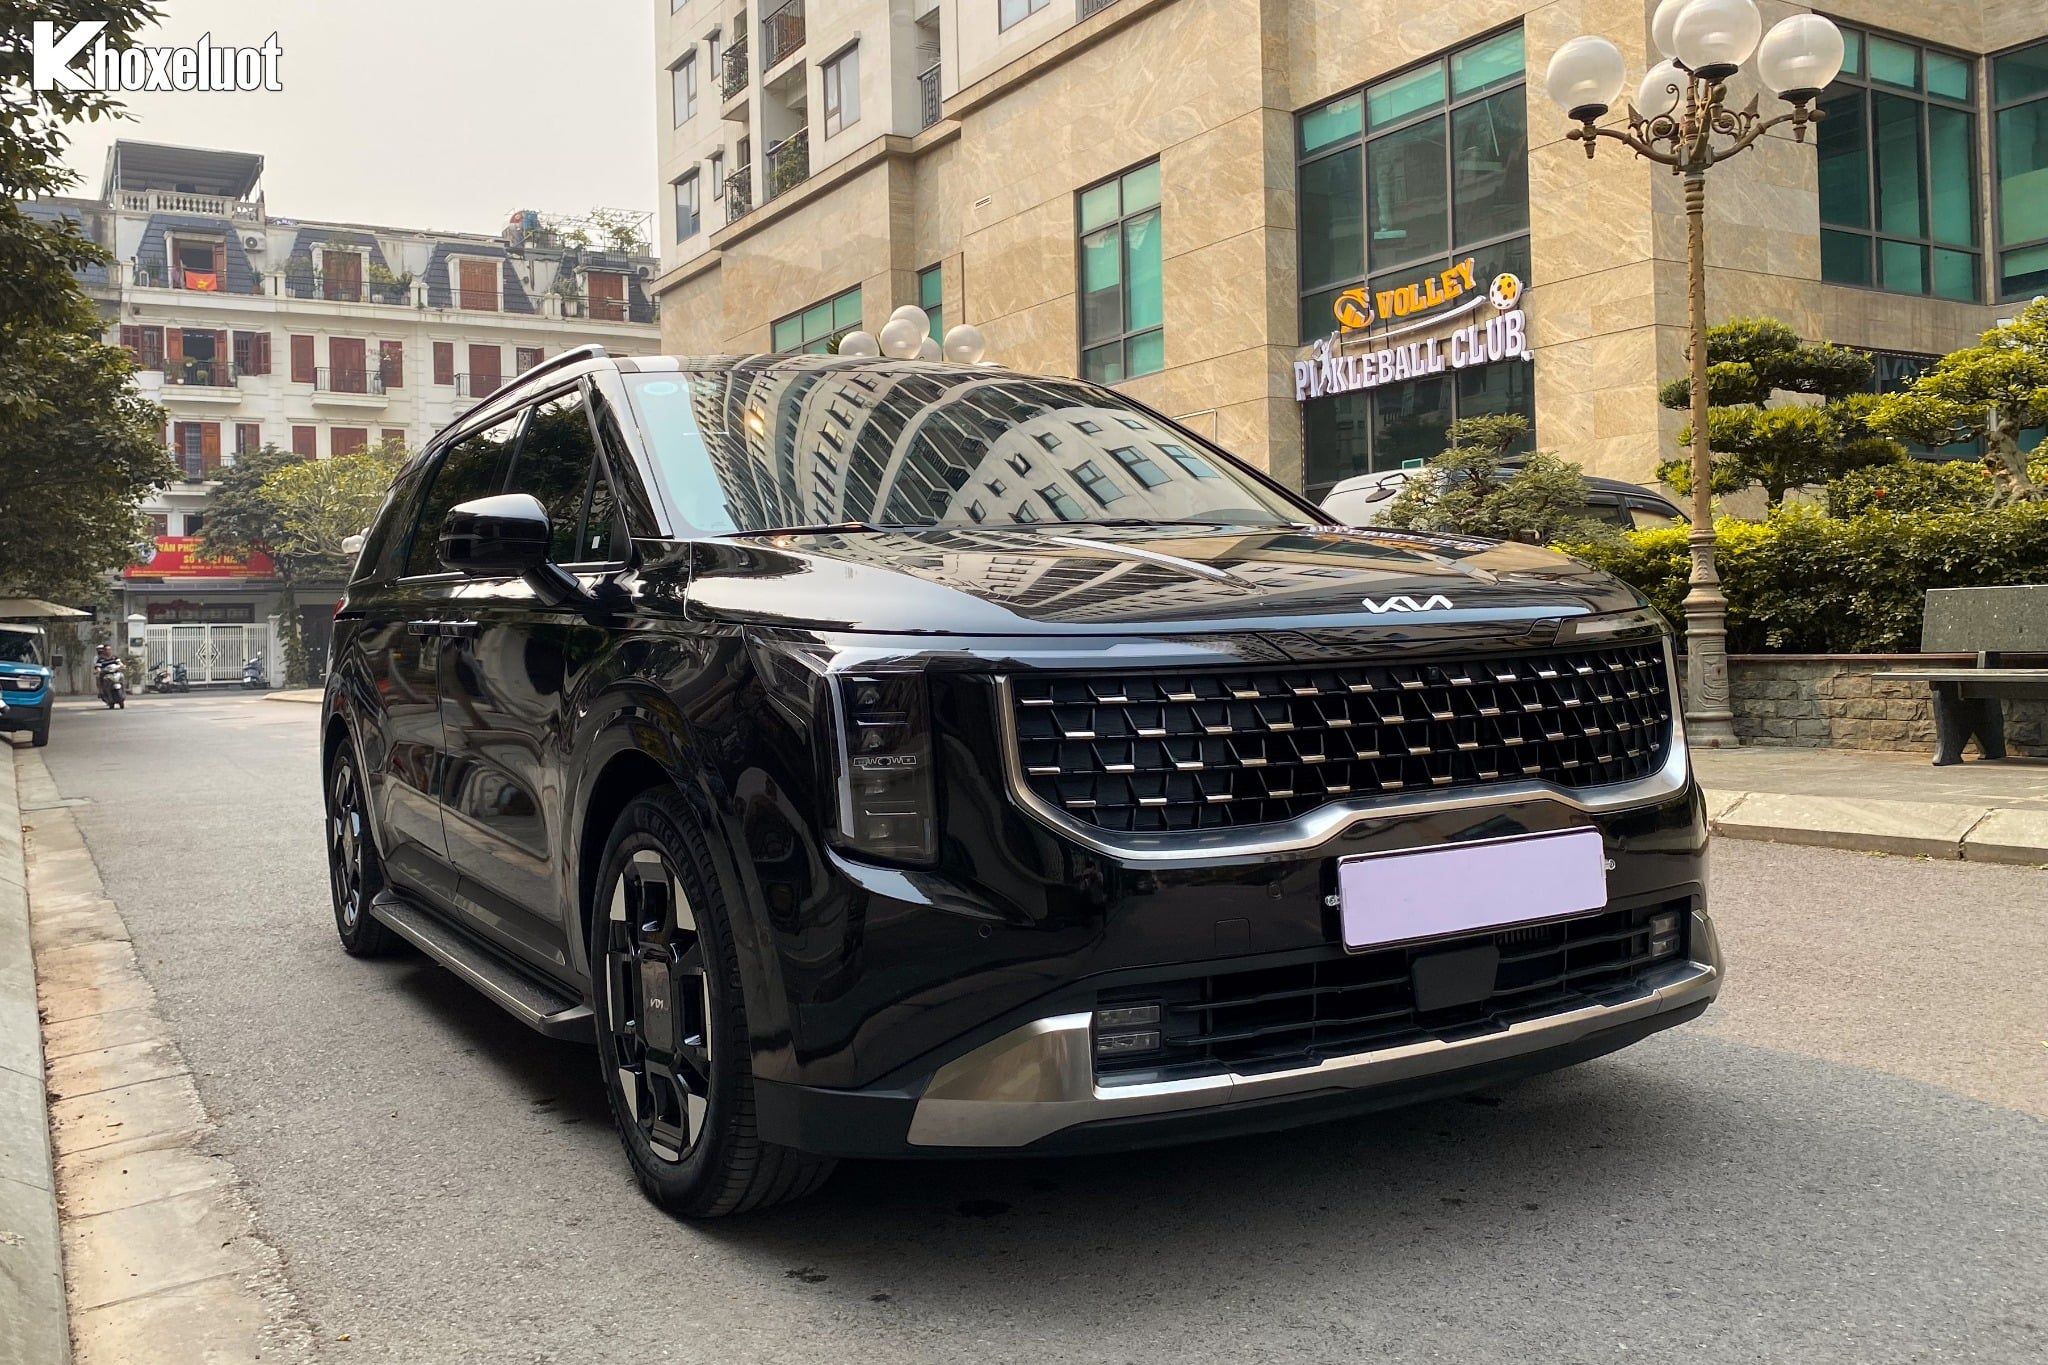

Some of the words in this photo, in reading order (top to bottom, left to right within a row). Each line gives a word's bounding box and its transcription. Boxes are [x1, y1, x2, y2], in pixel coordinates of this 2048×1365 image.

[1375, 257, 1477, 319] VOLLEY
[1293, 337, 1445, 402] PIKLEBALL
[1451, 309, 1526, 369] CLUB
